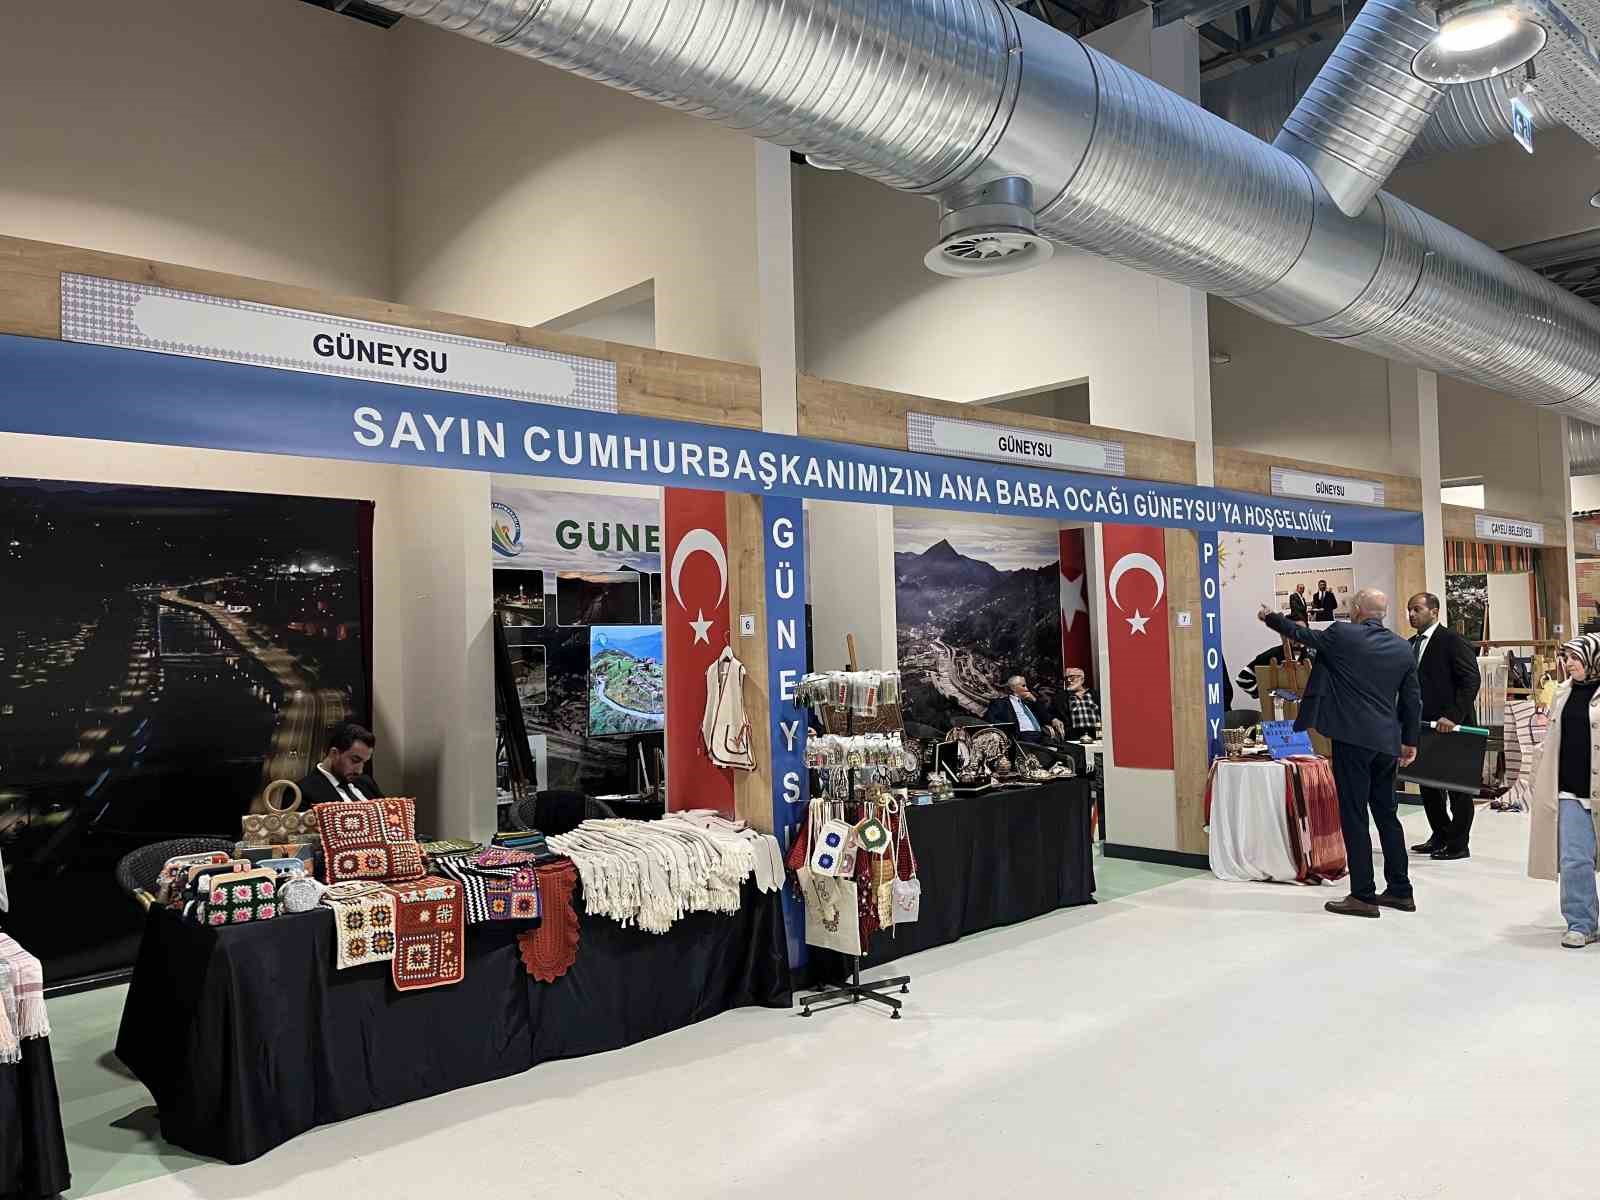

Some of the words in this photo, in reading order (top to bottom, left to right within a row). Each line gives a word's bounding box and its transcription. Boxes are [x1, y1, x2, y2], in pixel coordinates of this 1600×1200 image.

[312, 332, 448, 374] GÜNEYSU
[998, 434, 1053, 458] GÜNEYSU
[352, 405, 507, 459] SAYIN
[523, 425, 933, 499] CUMHURBAŞKANIMIZIN
[939, 472, 992, 504] ANA
[995, 478, 1061, 511] BABA
[1063, 485, 1129, 516] OCAĞI
[1244, 504, 1335, 533] HOŞGELDİNİZ
[1315, 481, 1345, 497] GÜNEYSU
[555, 519, 660, 553] GÜNE
[1203, 542, 1221, 740] POTOMY
